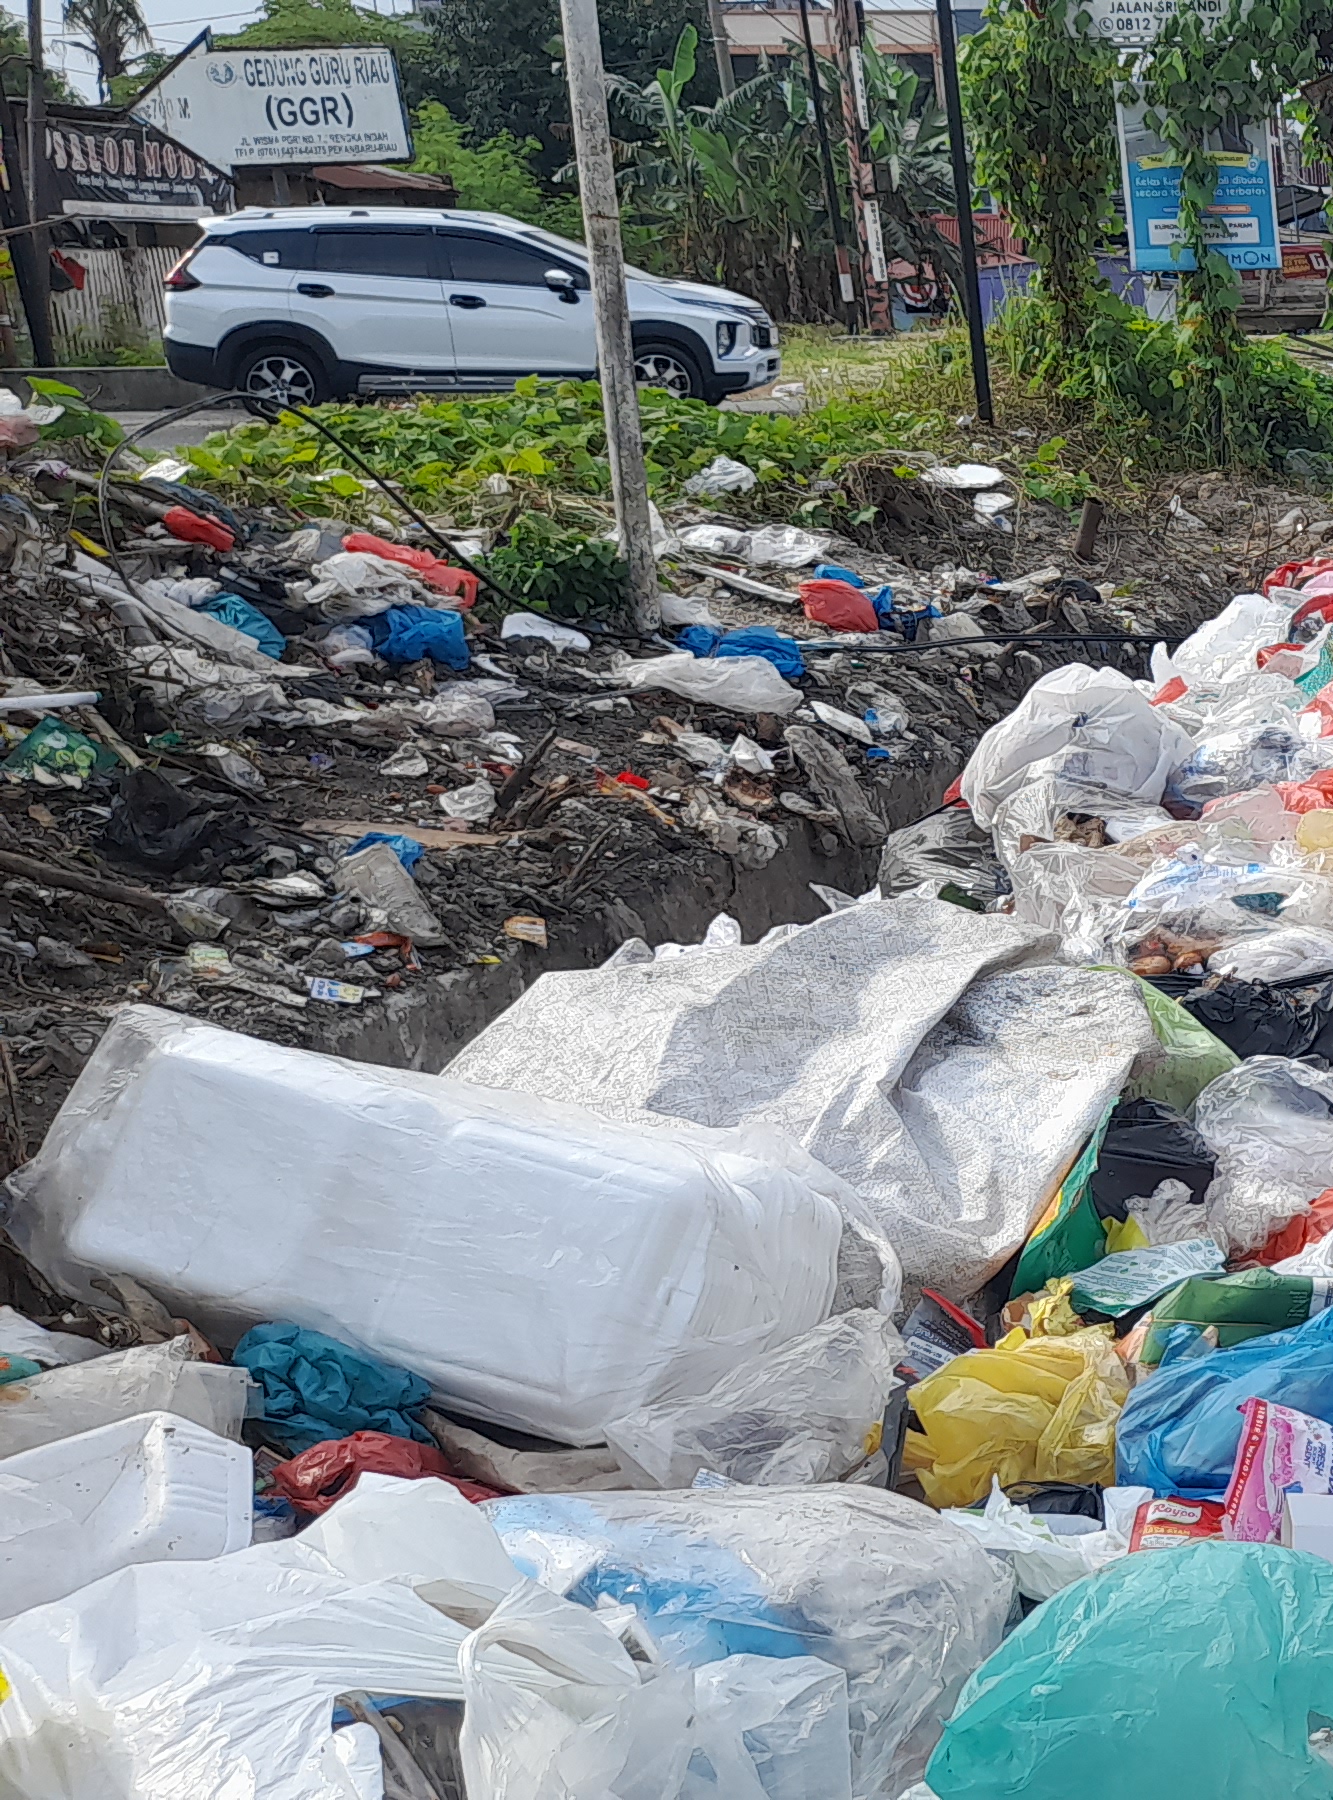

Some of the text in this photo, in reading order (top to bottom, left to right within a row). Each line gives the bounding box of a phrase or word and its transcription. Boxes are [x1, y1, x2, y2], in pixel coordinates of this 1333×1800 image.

[1110, 0, 1222, 13] JALAN SRIANDI
[1116, 18, 1151, 31] 0812
[243, 52, 390, 88] GEDUNG GURU RIAU
[265, 92, 354, 131] (GGR)
[1315, 1441, 1327, 1477] FRESH
